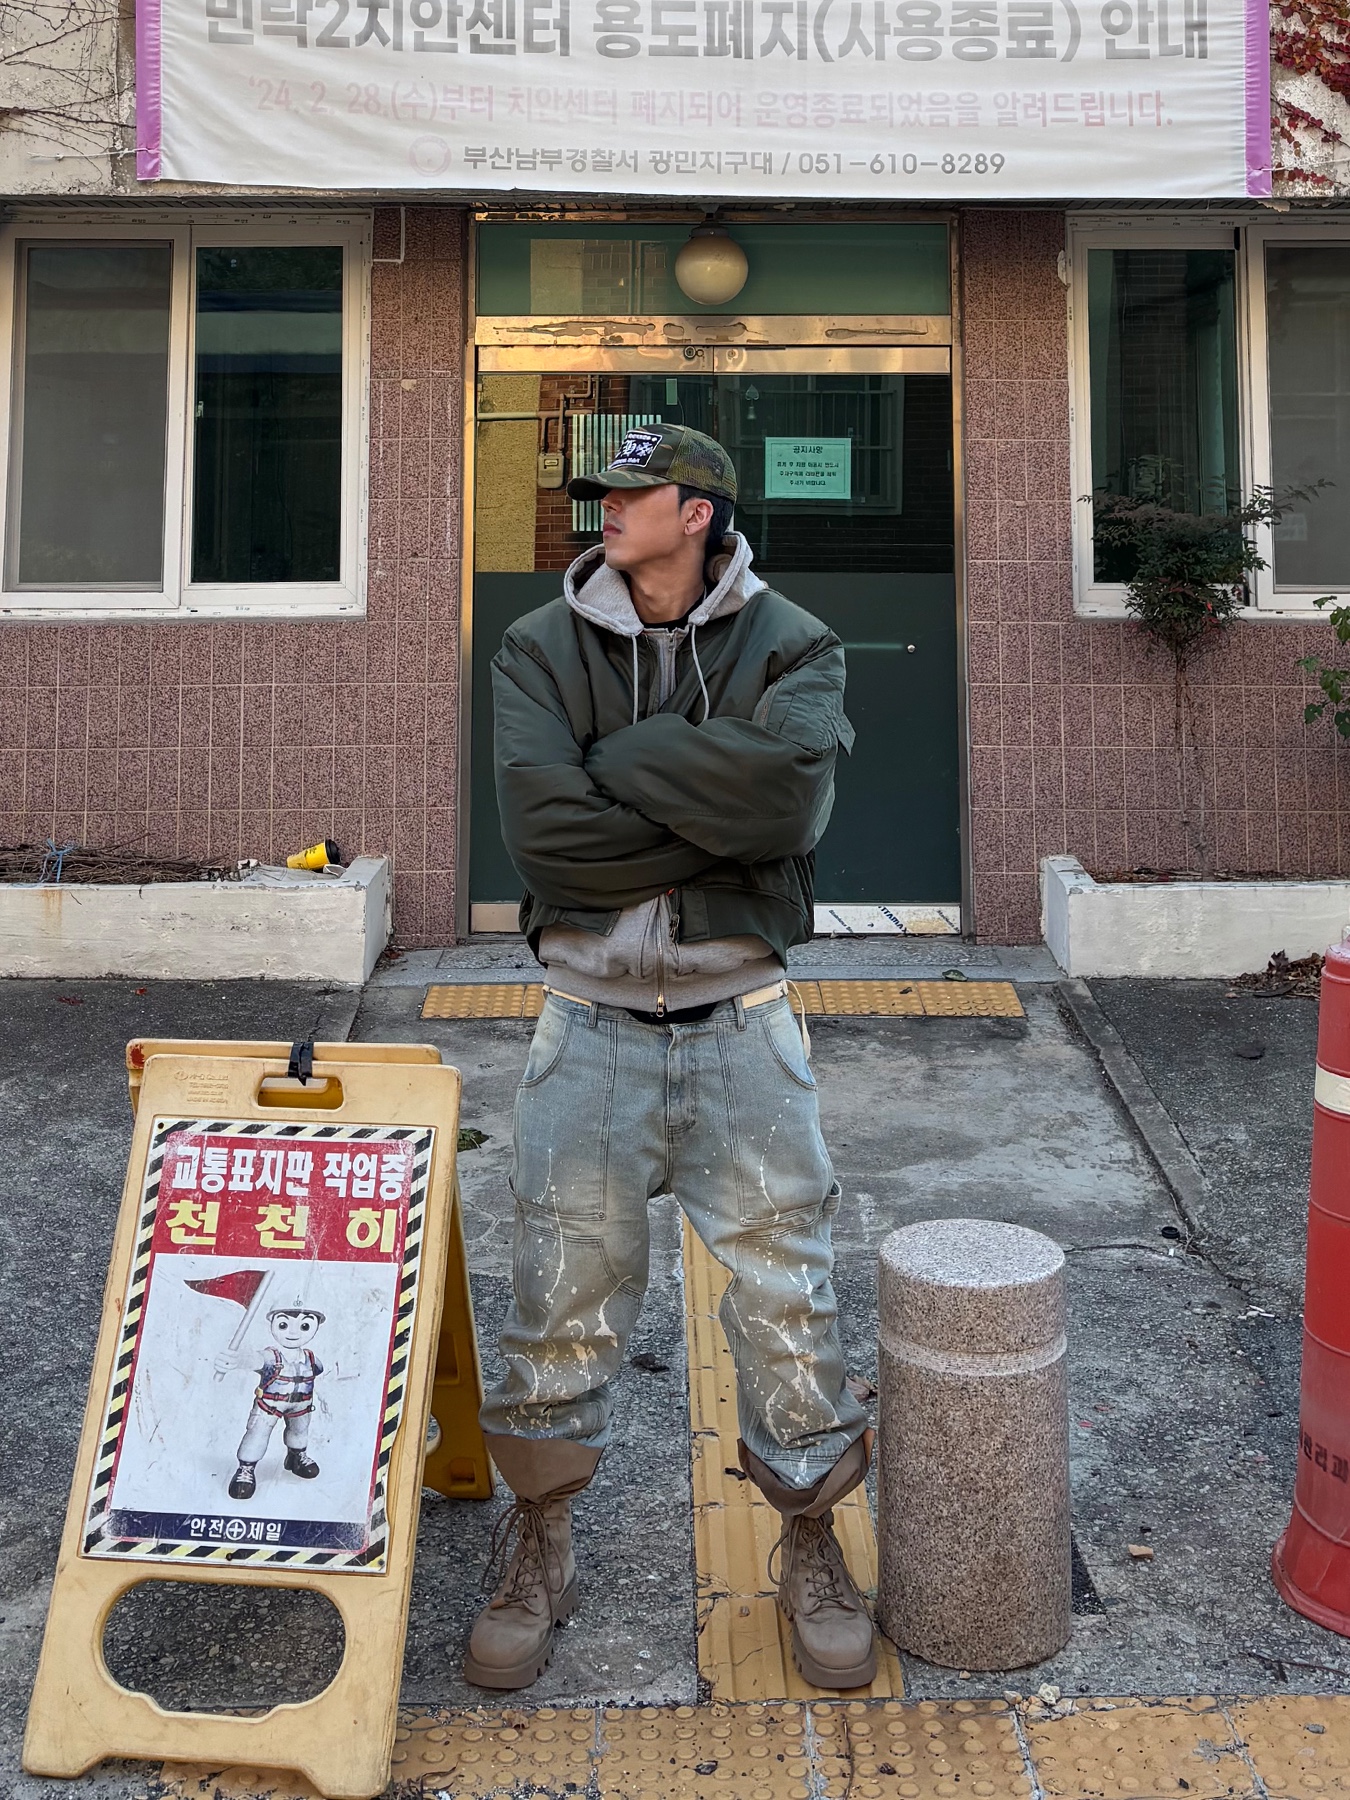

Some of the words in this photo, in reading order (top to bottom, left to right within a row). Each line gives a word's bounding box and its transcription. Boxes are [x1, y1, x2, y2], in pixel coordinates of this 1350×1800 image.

[593, 0, 1081, 62] 용도폐지(사용종료)
[1101, 0, 1208, 59] 안내
[507, 86, 618, 125] 치안센터
[630, 89, 741, 127] 폐지되어
[753, 90, 982, 129] 운영종료되었음을
[993, 89, 1173, 128] 알려드립니다.
[463, 146, 639, 173] 부산남부경찰서
[648, 150, 773, 175] 광민지구대
[799, 153, 1005, 175] 051-610-8289
[172, 1146, 314, 1197] 교통표지판
[322, 1152, 406, 1201] 작업중
